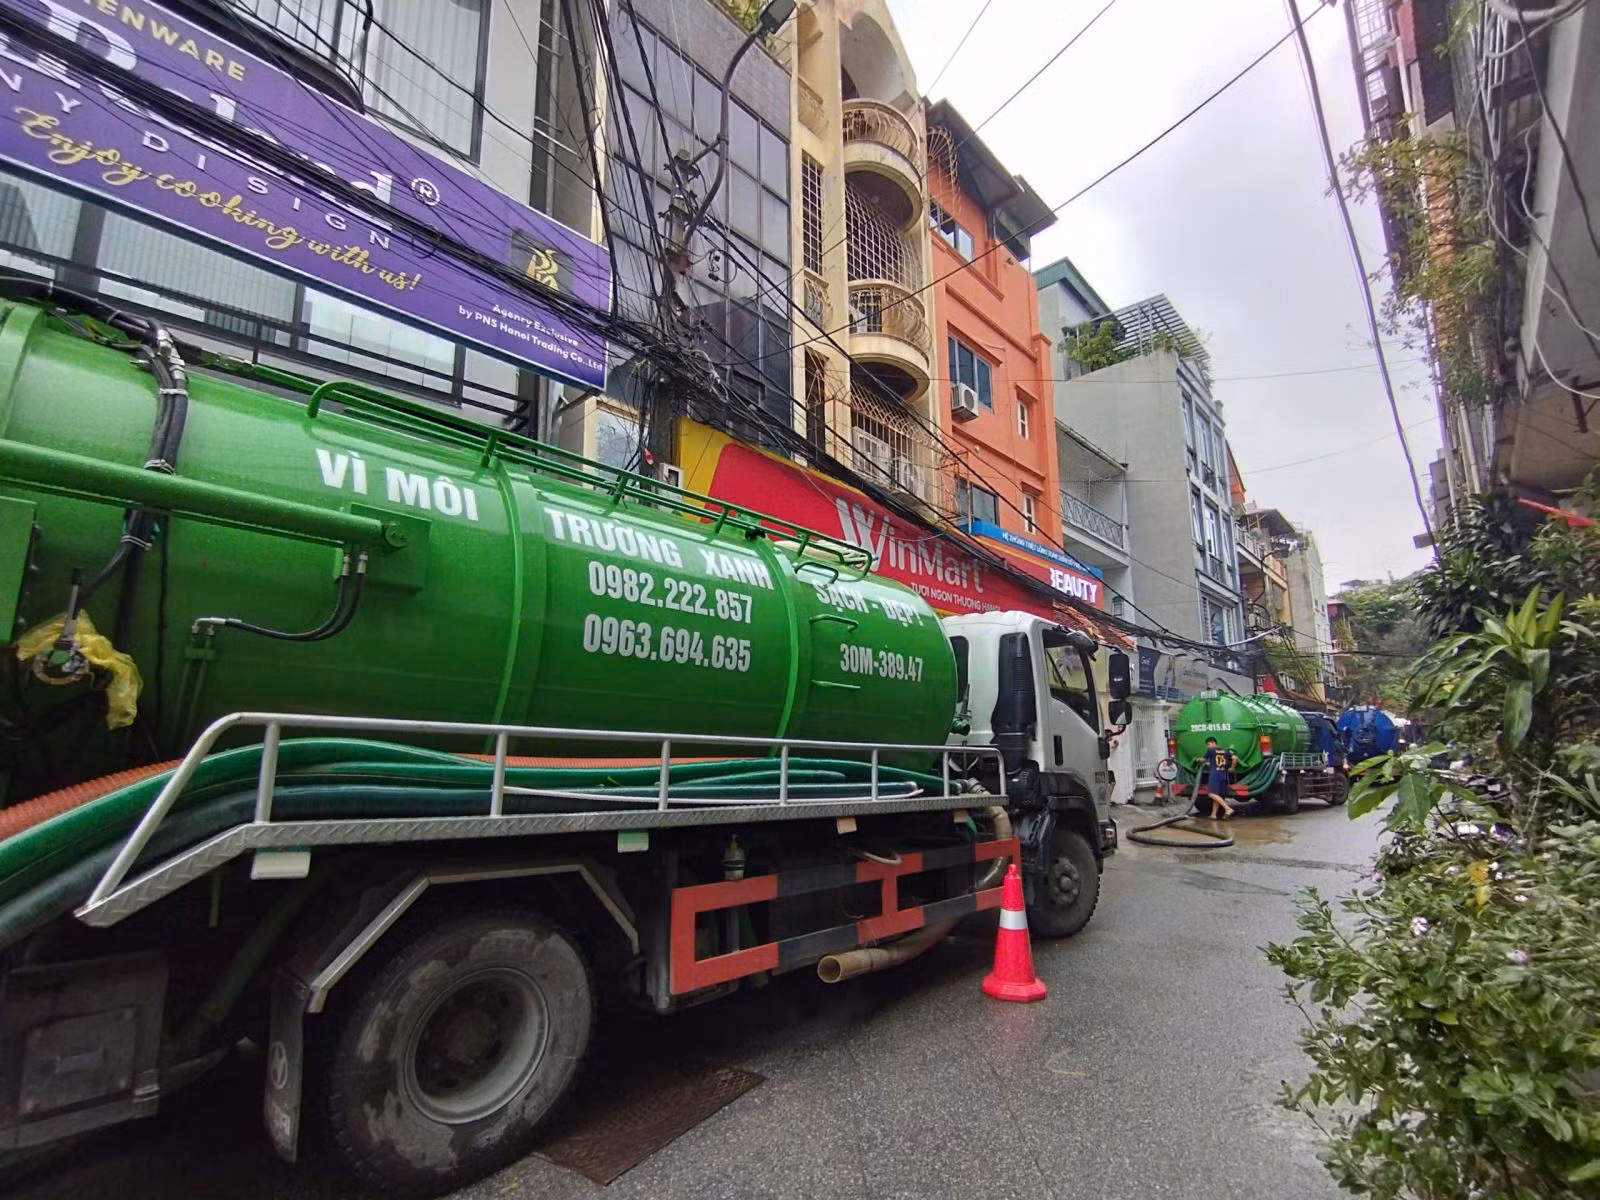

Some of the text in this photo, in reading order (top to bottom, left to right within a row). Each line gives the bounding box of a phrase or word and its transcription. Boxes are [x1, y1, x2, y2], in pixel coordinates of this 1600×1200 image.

[83, 0, 245, 81] ENWARE
[14, 107, 421, 290] Enjoy cooking with us!
[458, 305, 472, 319] by
[475, 312, 498, 328] PNS
[500, 322, 530, 342] Hanoi
[532, 335, 569, 359] Trading
[534, 322, 579, 347] Exclusive
[315, 448, 479, 522] VÌ MÔI
[543, 507, 774, 590] TRƯỜNG XANH
[836, 497, 983, 594] WinMart
[588, 560, 753, 624] 0982.222.857
[931, 588, 953, 603] NGON
[583, 613, 751, 673] 0963.694.635
[840, 643, 923, 682] 30M-389.47
